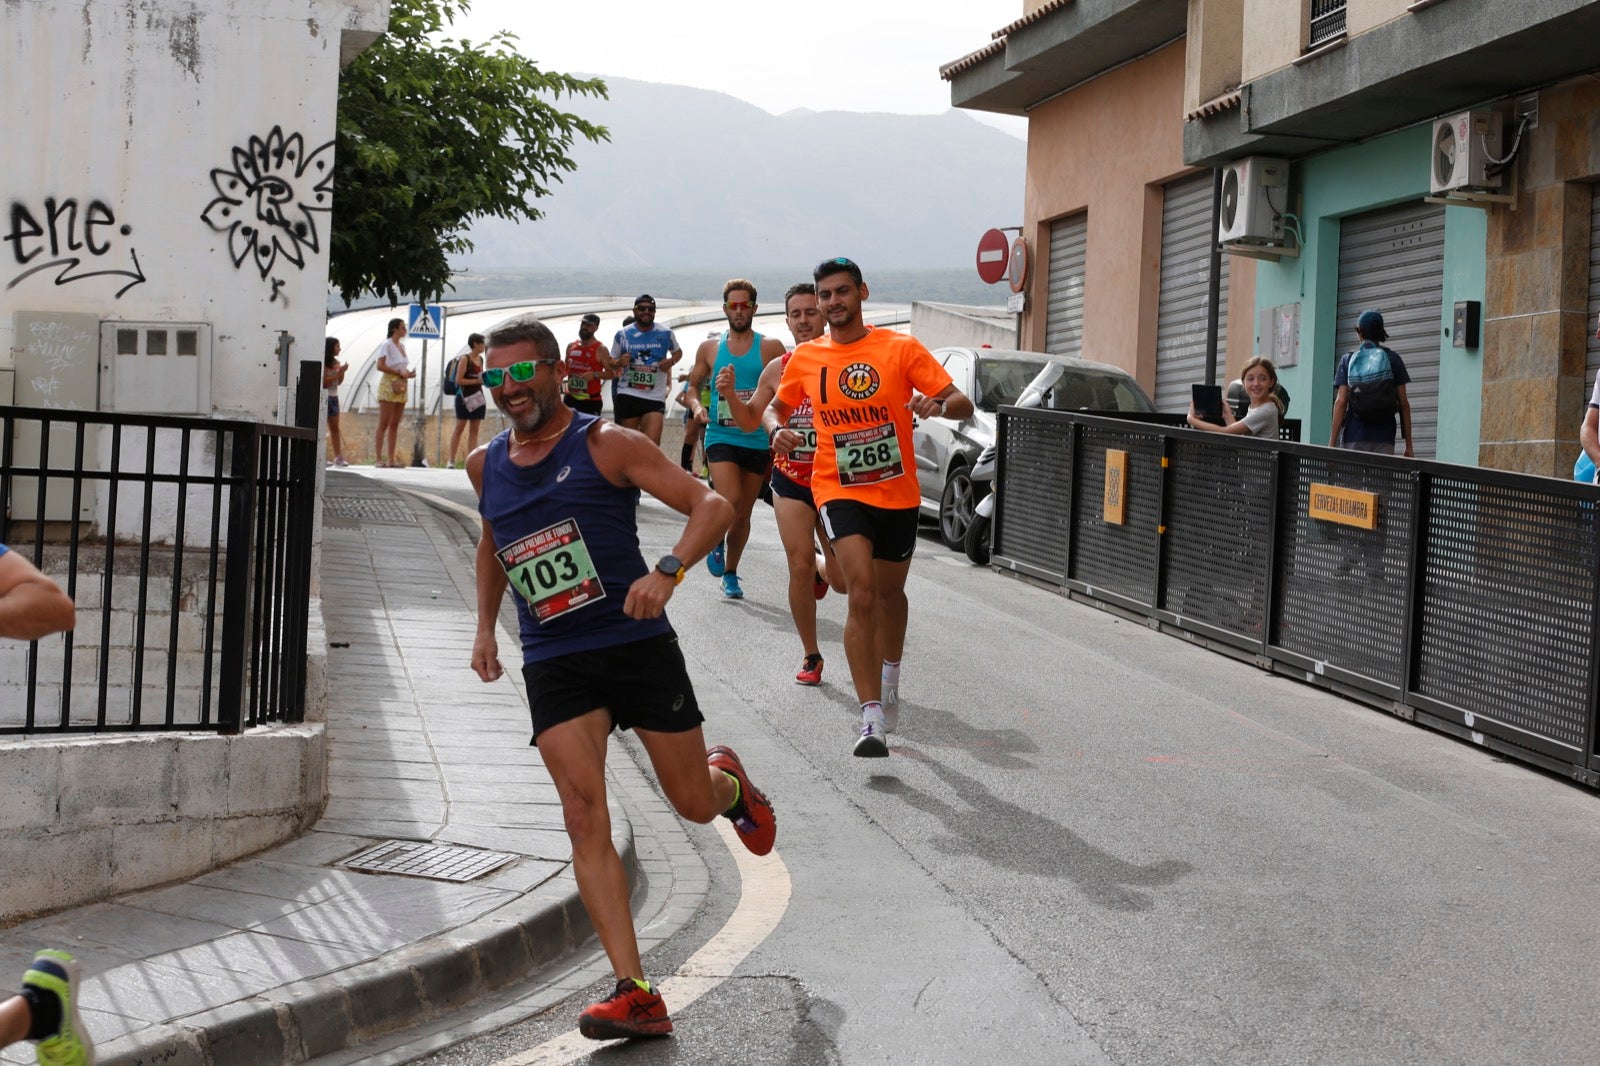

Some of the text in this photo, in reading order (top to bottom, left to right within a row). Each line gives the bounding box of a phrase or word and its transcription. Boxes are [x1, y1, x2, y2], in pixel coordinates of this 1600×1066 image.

[633, 372, 653, 383] 583
[847, 363, 871, 373] BEER
[841, 382, 878, 399] RUNNERS
[820, 406, 888, 427] RUNNING
[848, 443, 891, 469] 268
[1314, 492, 1368, 520] CERVEZAS ALHAMBRA
[512, 545, 526, 557] GRAN
[525, 534, 546, 550] PREMIO
[545, 531, 554, 543] DE
[553, 523, 572, 538] FONDO
[520, 551, 579, 596] 103
